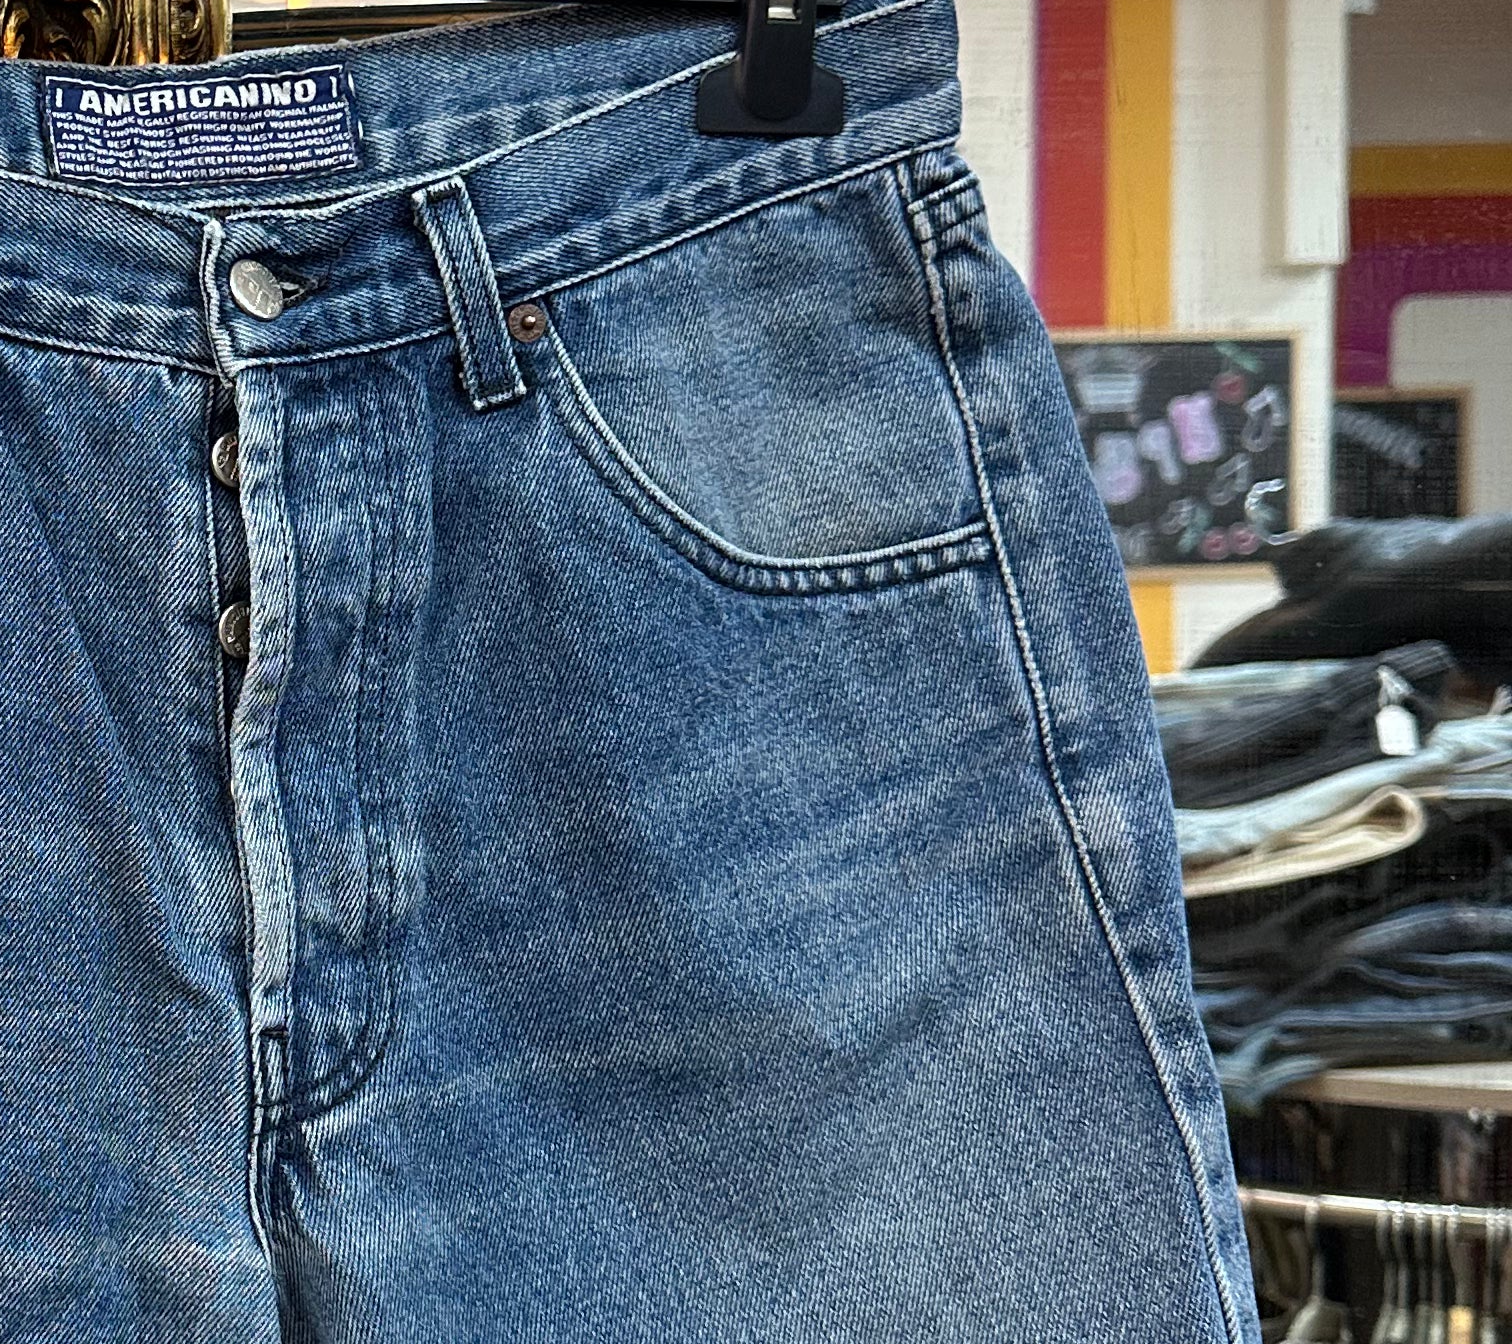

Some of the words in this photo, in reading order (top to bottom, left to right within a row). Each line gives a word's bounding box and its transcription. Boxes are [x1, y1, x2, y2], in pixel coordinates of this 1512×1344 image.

[79, 78, 317, 117] AMERICANINO
[176, 111, 239, 121] REGISTERED
[248, 110, 262, 120] AN
[263, 107, 307, 118] ORIGINAL
[56, 121, 100, 135] PRODUCT
[103, 126, 174, 138] SYNONYMOUS
[174, 123, 201, 134] WITH
[203, 123, 227, 132] HIGH
[229, 121, 266, 133] QUALITY
[269, 112, 344, 130] WORKMANSHIP
[56, 142, 77, 150] AND
[182, 144, 232, 156] WASHING
[61, 132, 85, 141] AND
[107, 138, 131, 149] BEST
[58, 151, 95, 162] STYLES
[167, 155, 224, 168] PIONEERED
[267, 164, 288, 173] AND
